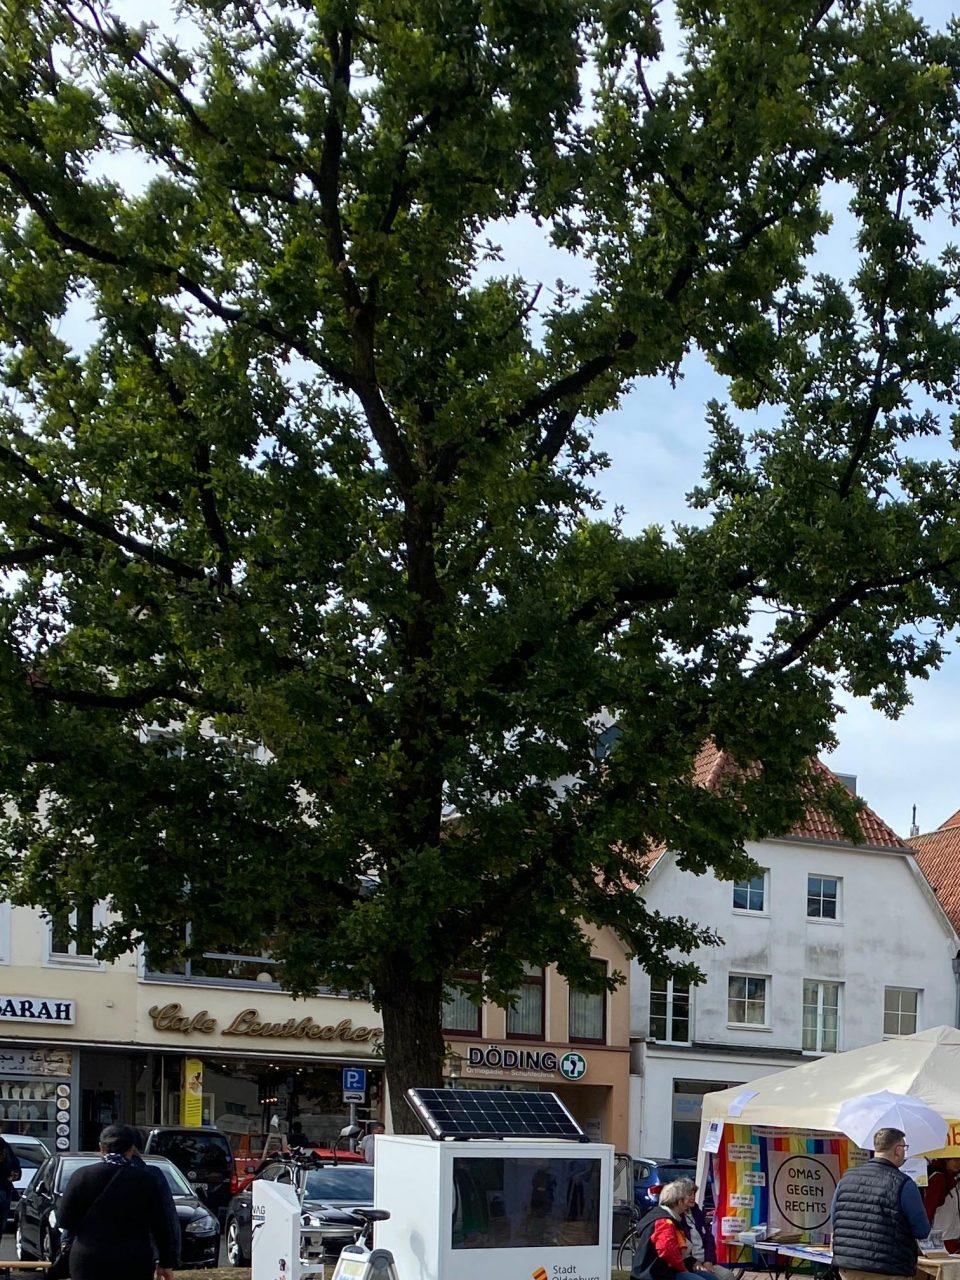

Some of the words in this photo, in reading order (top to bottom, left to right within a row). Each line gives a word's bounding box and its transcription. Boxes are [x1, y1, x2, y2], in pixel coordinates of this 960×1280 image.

[221, 1008, 384, 1042] Leutbecher
[468, 1045, 557, 1071] DÖDING
[346, 1071, 359, 1087] P
[788, 1167, 821, 1181] OMAS
[786, 1184, 824, 1197] GEGEN
[785, 1200, 827, 1214] RECHTS
[553, 1264, 577, 1275] Stadt
